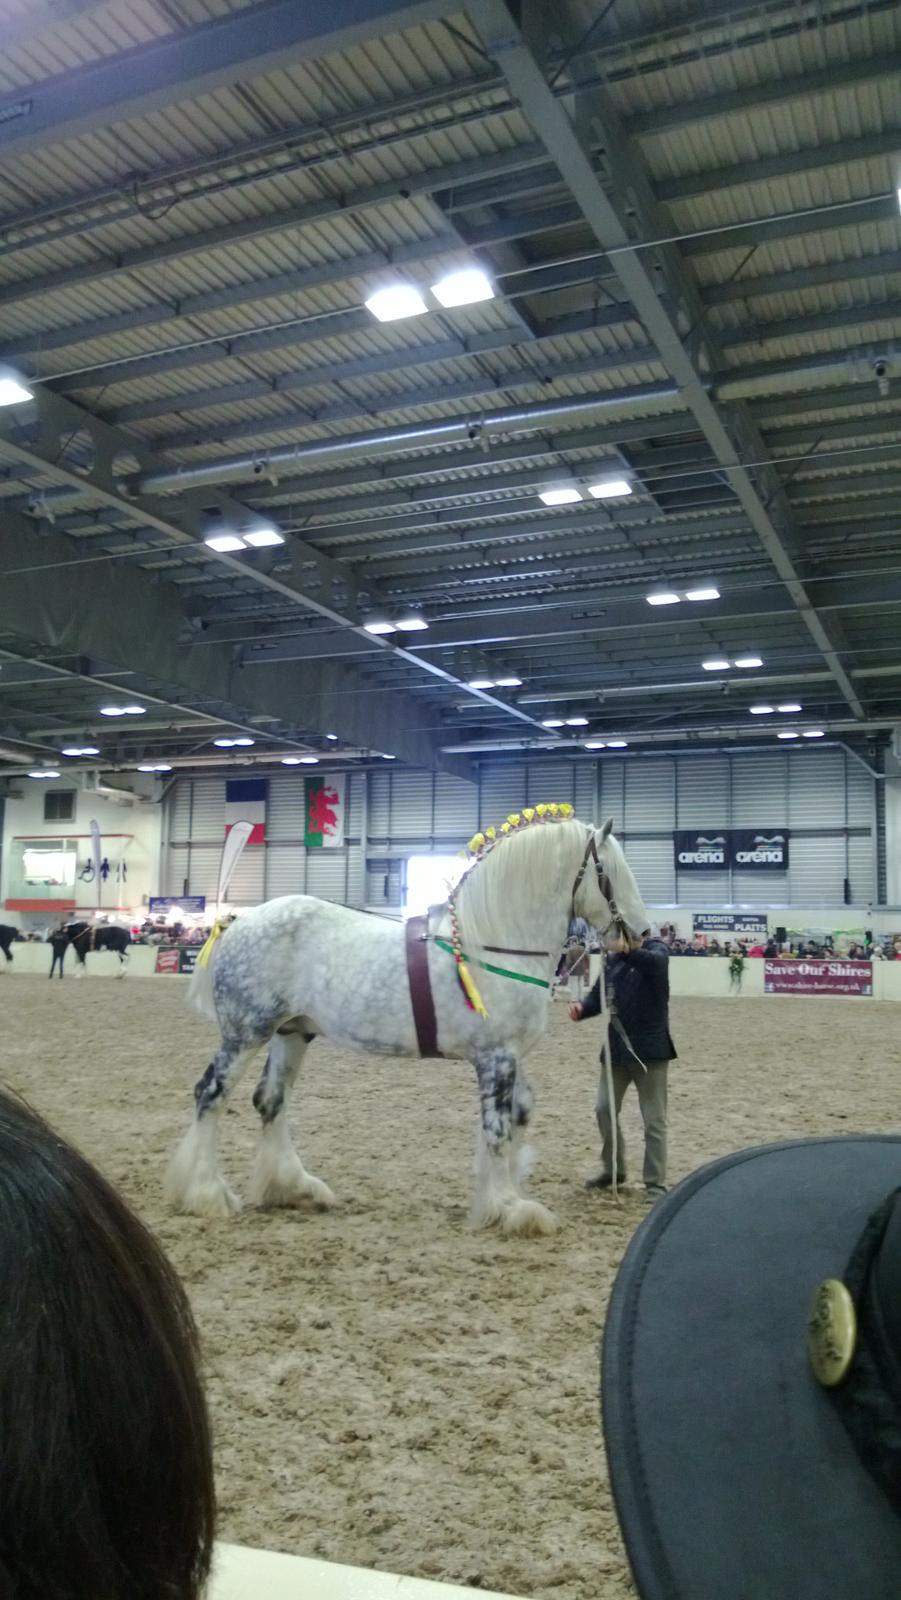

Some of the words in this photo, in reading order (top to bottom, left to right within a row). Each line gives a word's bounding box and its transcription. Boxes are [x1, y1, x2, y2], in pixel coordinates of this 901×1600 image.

[678, 852, 724, 863] arena
[736, 851, 783, 863] arena
[765, 962, 795, 975] Save
[797, 963, 826, 976] Our
[828, 963, 872, 977] Shires
